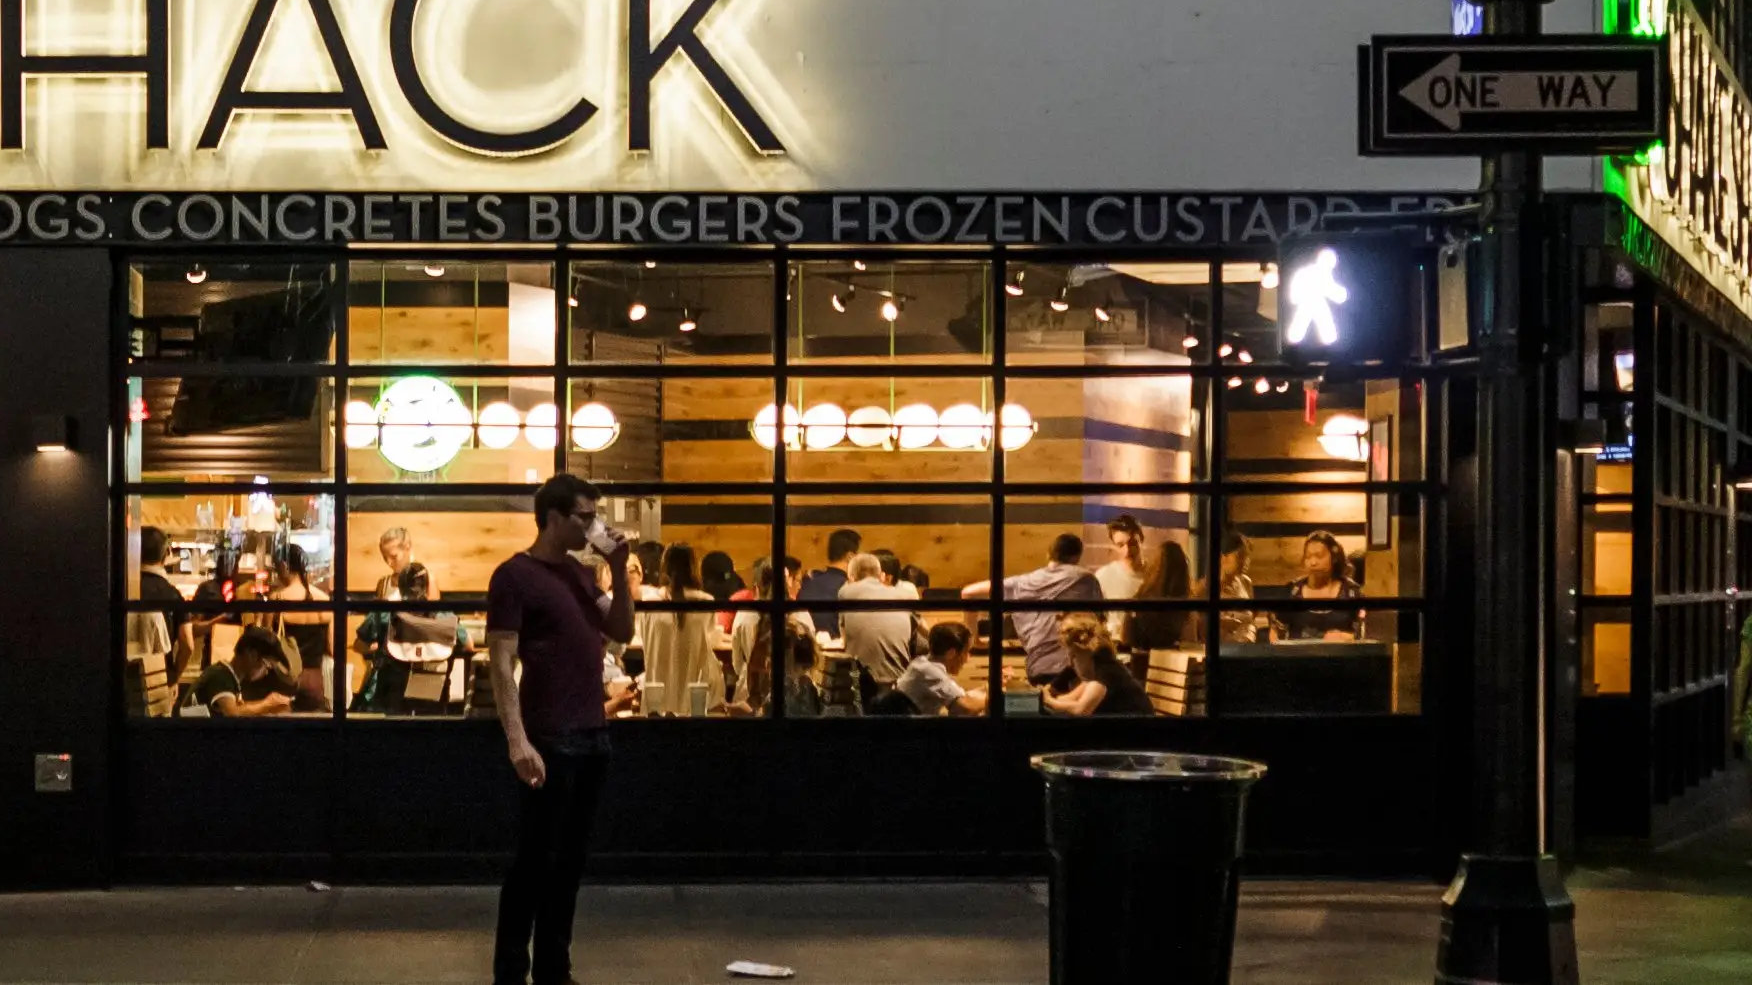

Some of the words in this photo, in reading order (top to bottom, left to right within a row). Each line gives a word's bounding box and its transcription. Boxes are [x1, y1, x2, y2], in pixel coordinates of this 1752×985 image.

[1428, 74, 1499, 109] ONE
[1538, 74, 1618, 109] WAY
[130, 193, 508, 241] CONCRETES
[528, 194, 805, 242] BURGERS
[832, 195, 1070, 243] FROZEN
